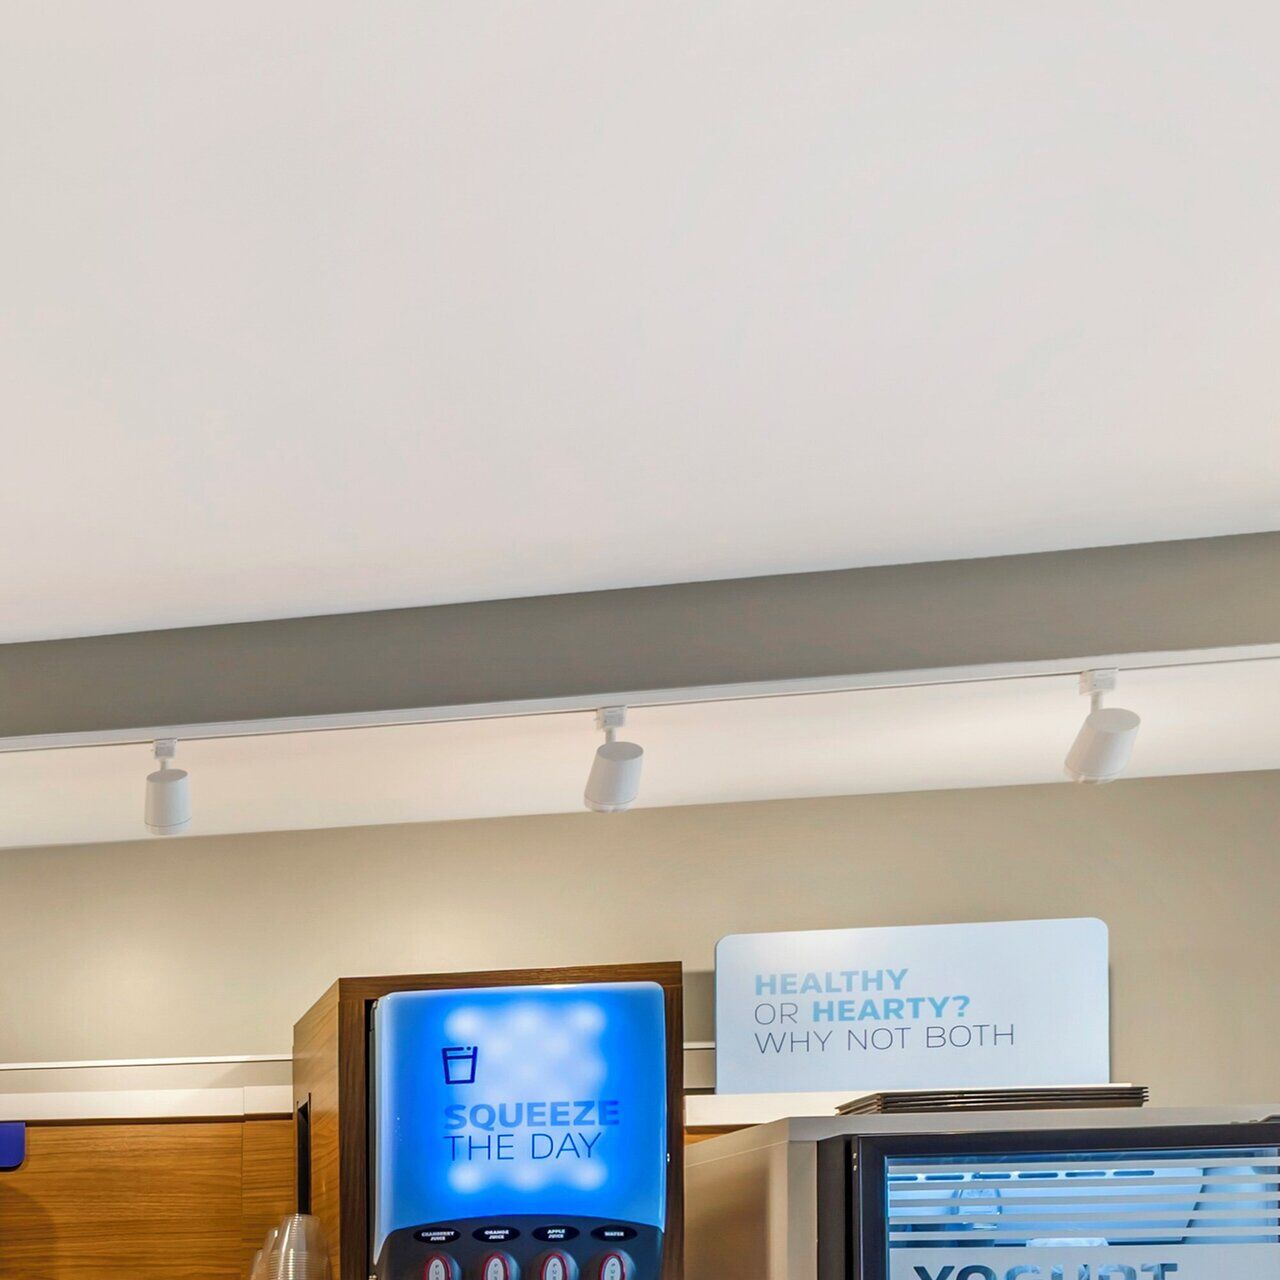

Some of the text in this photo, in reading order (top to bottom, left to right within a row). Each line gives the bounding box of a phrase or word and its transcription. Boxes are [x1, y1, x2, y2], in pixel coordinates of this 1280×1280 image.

[754, 968, 909, 996] HEALTHY
[754, 995, 971, 1026] OR HEARTY?
[754, 1023, 1015, 1054] WHY NOT BOTH
[443, 1100, 620, 1132] SQUEEZE
[442, 1131, 602, 1162] THE DAY
